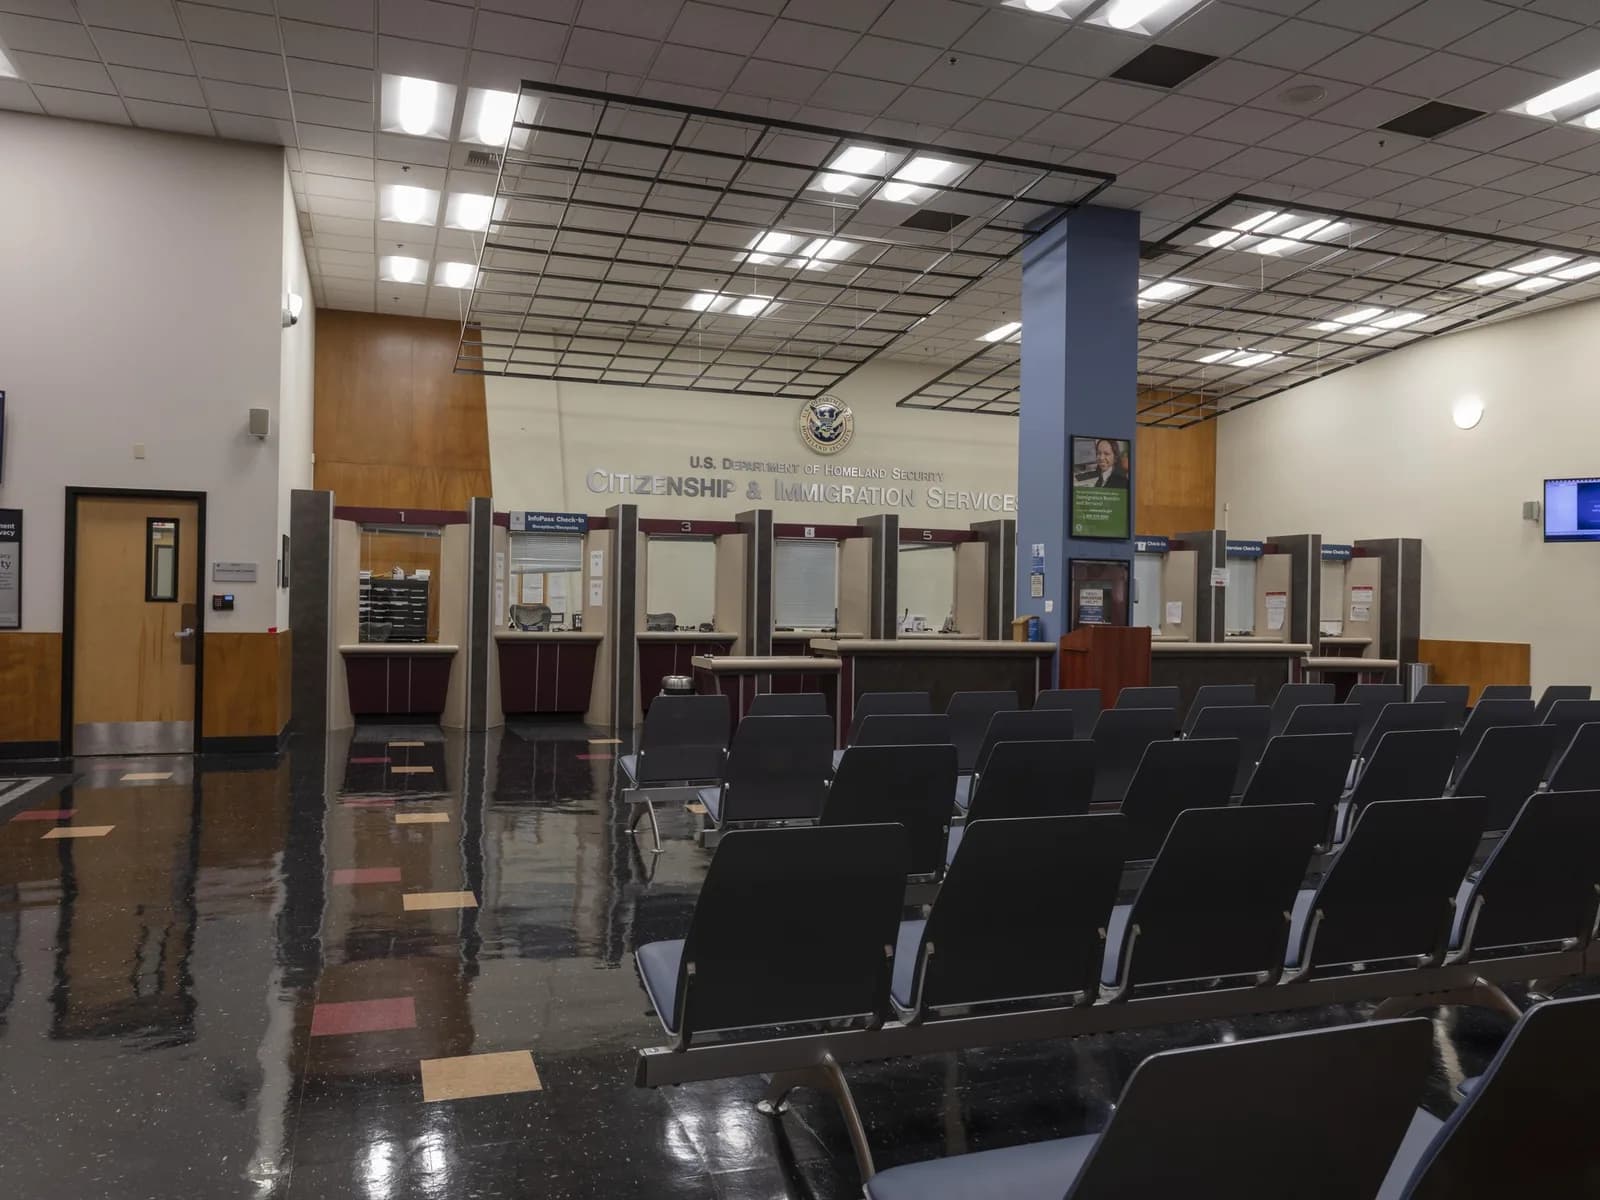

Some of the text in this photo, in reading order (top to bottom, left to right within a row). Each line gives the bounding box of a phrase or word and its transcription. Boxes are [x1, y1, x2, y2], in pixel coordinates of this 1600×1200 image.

[689, 455, 717, 470] U.S.
[823, 464, 887, 479] HOMELAND
[891, 467, 945, 482] SECURITY
[586, 466, 737, 498] CITIZENSHIP
[745, 480, 762, 501] &
[773, 479, 916, 508] IMMIGRATION
[399, 511, 406, 522] 1
[527, 514, 585, 523] InfoPass Check-In
[680, 521, 692, 532] 3
[922, 530, 933, 540] 5
